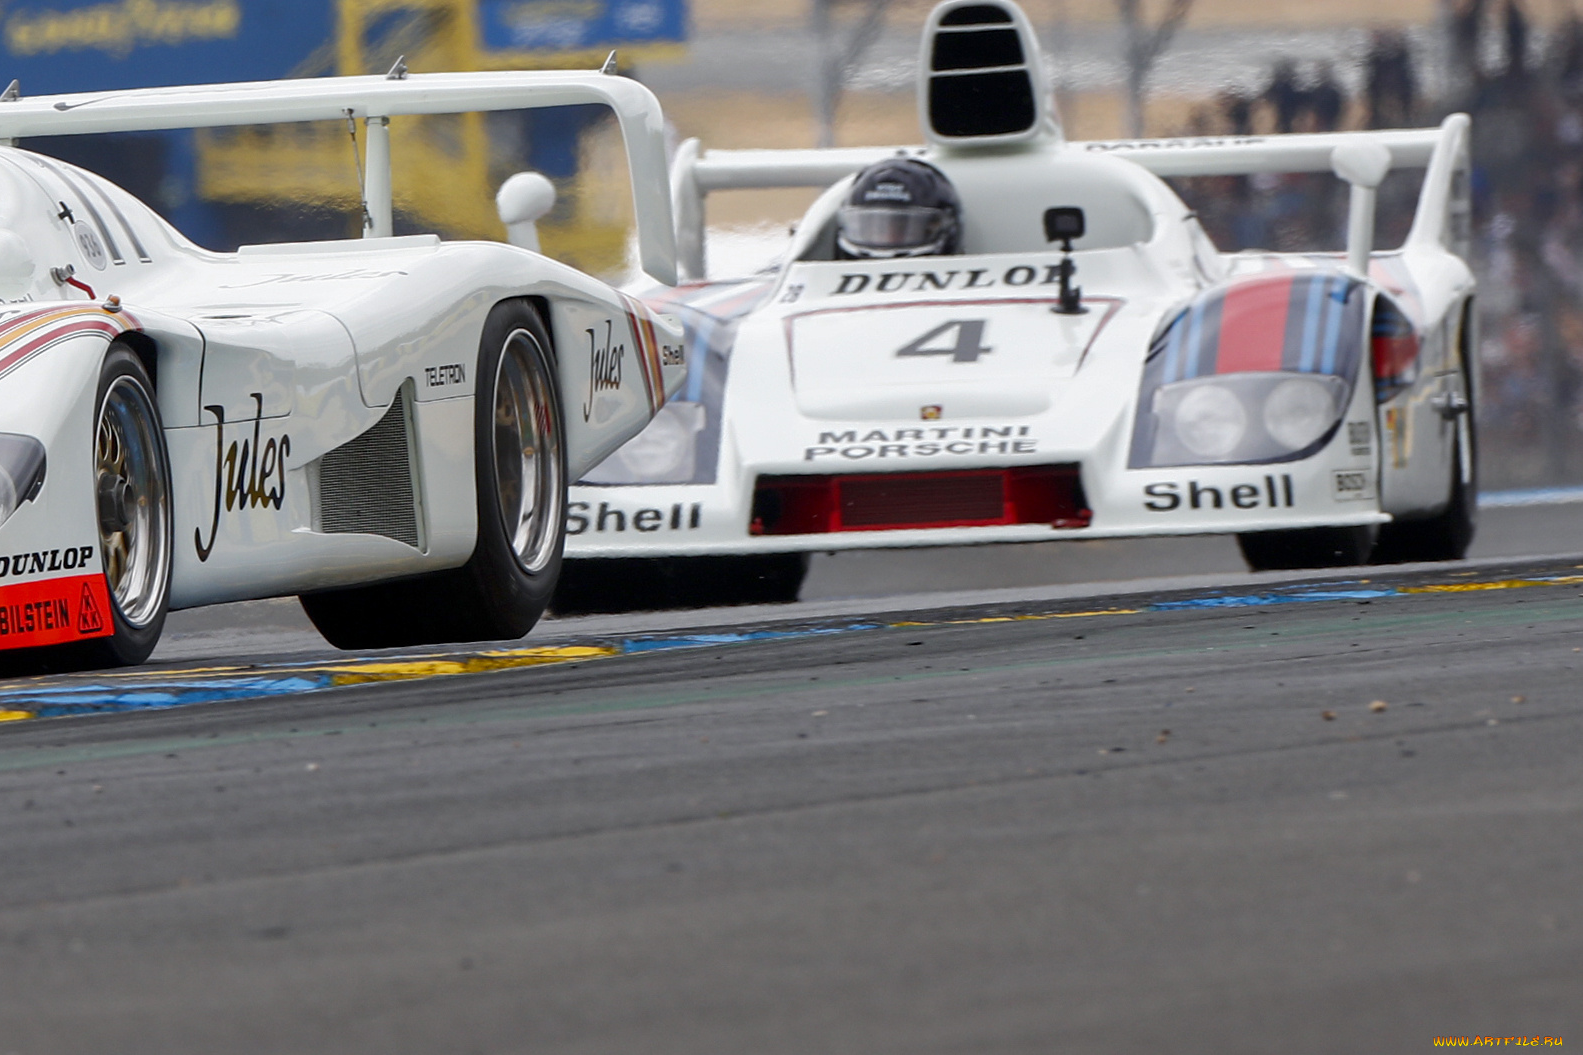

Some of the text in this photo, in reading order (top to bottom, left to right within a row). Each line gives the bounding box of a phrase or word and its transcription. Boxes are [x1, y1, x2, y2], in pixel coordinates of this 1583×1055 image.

[830, 264, 1077, 296] DUNLOP
[662, 345, 685, 365] Shell
[894, 318, 993, 363] 4
[424, 363, 466, 388] TELETRON
[583, 319, 624, 423] Jules
[804, 438, 1038, 461] PORSCHE
[818, 425, 1030, 444] MARTINI
[195, 393, 291, 562] Jules
[1143, 474, 1295, 512] Shell
[566, 500, 702, 536] Shell
[0, 598, 70, 636] BILSTEIN
